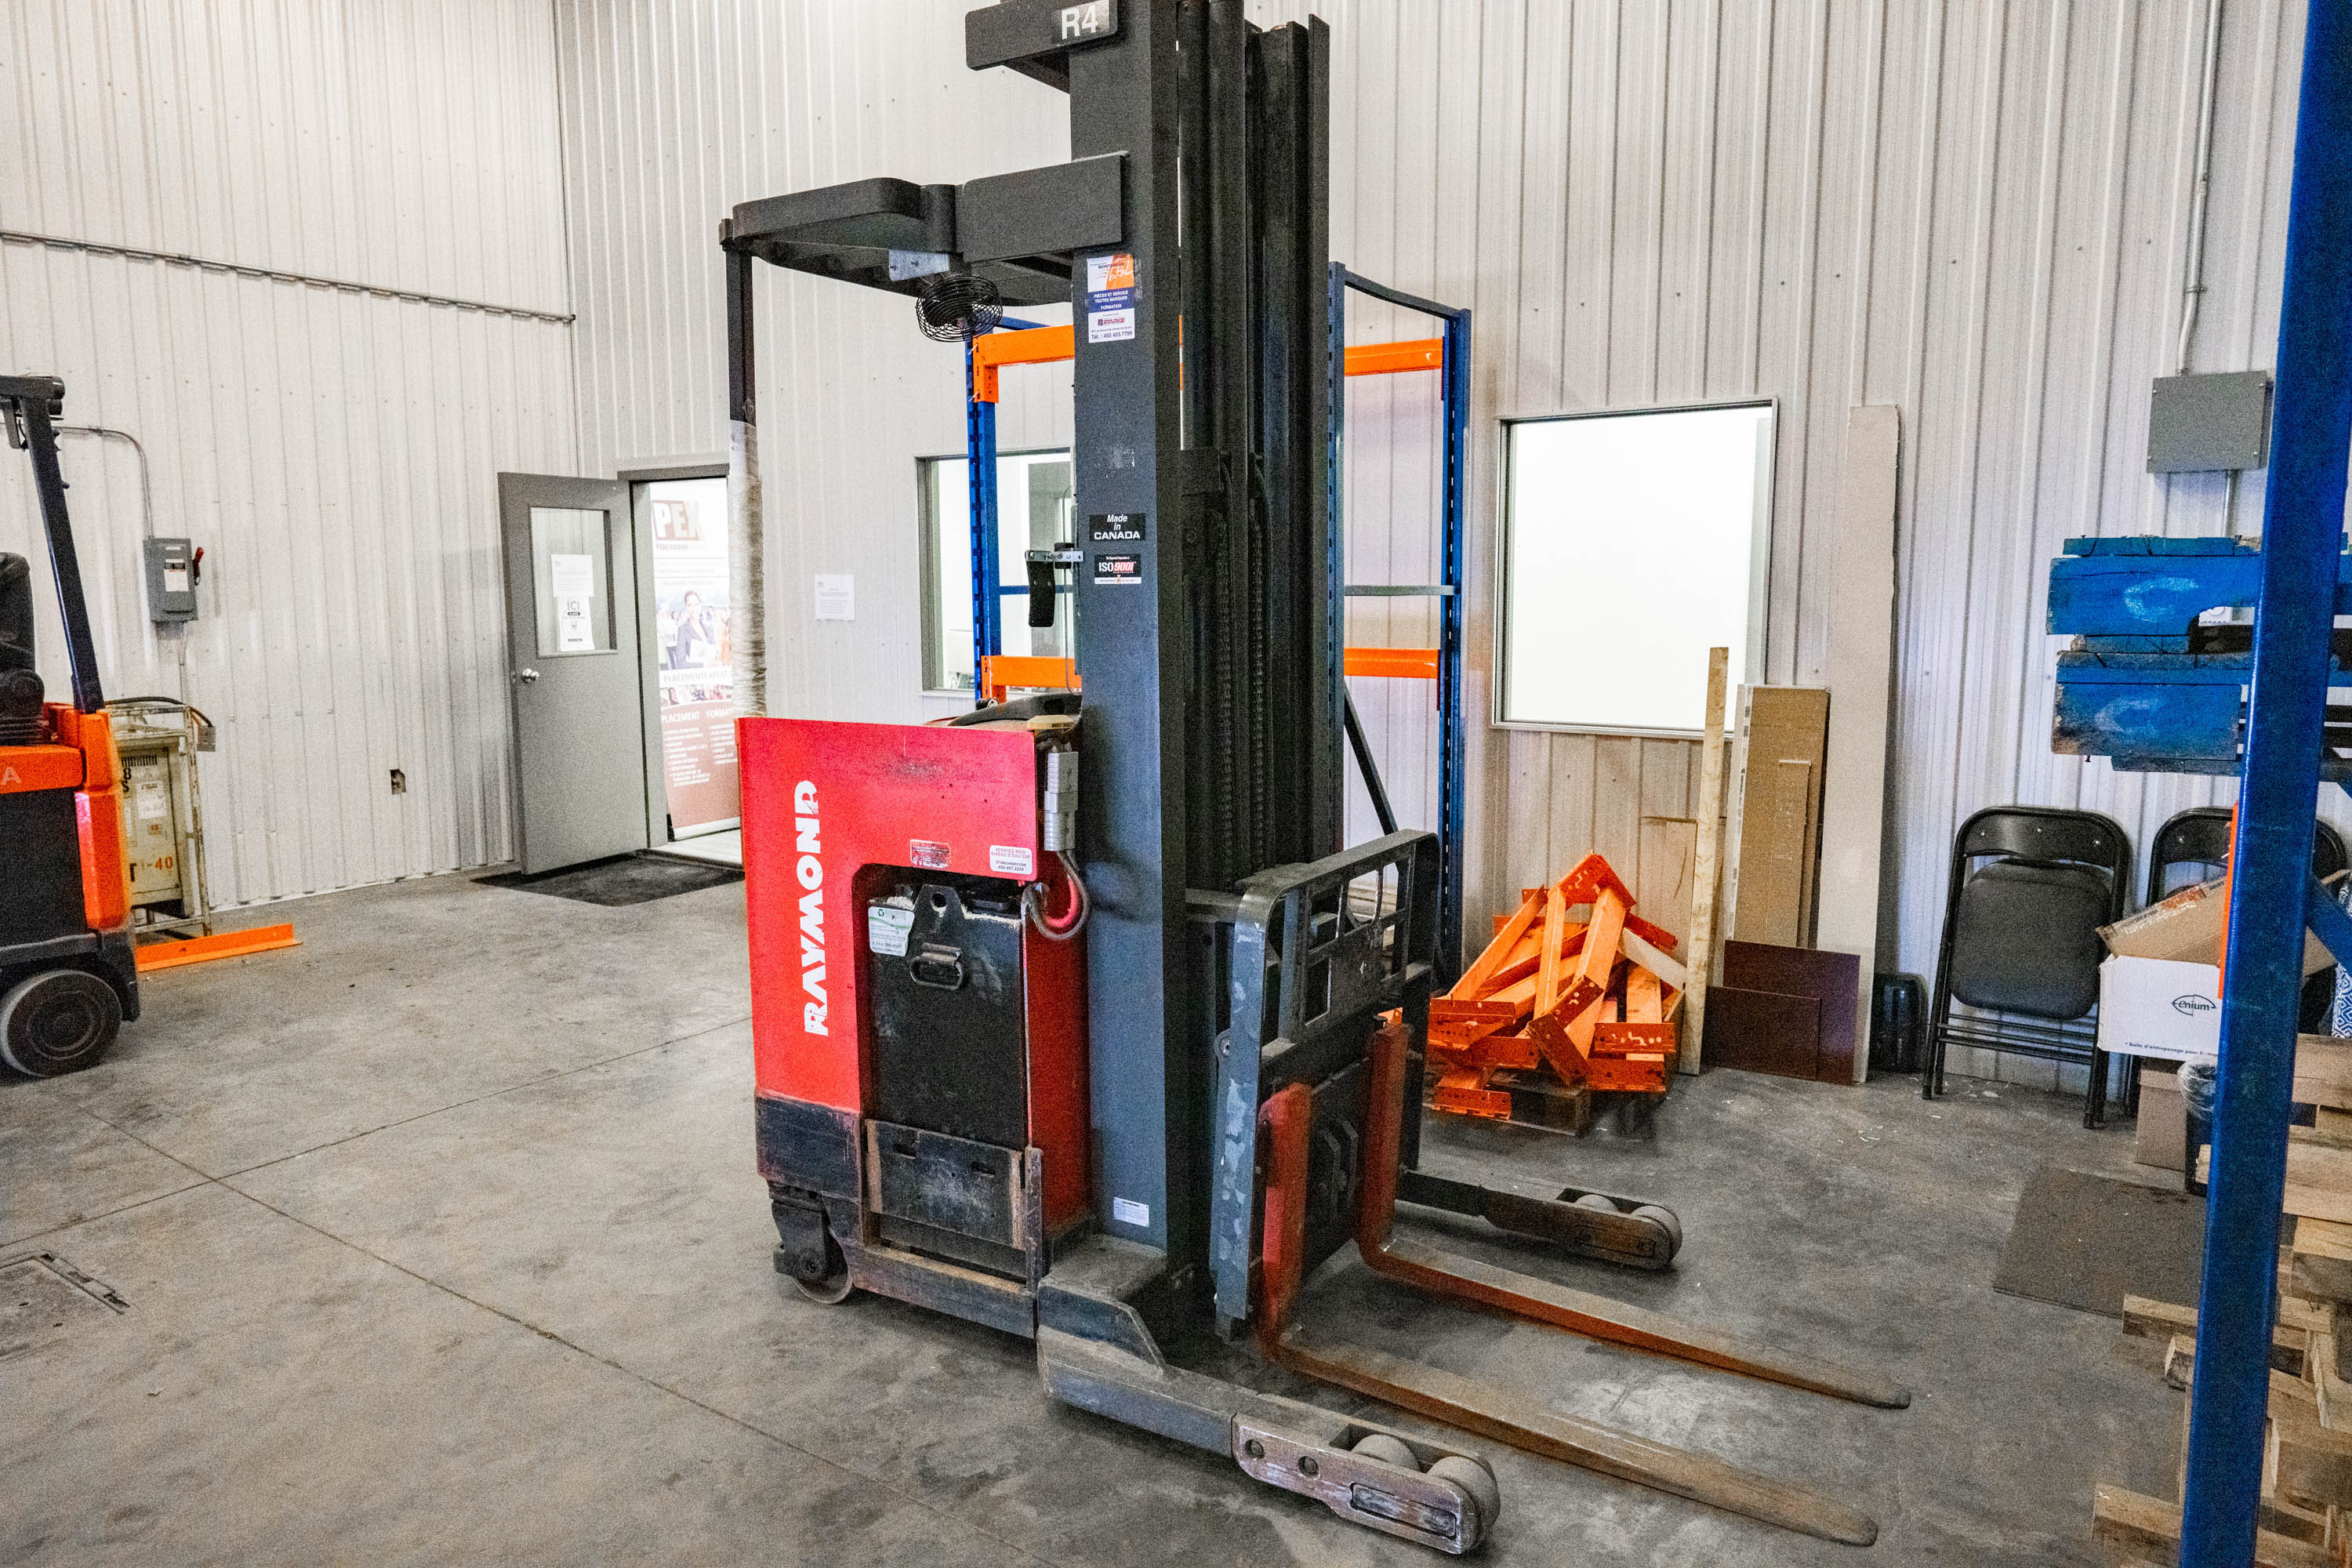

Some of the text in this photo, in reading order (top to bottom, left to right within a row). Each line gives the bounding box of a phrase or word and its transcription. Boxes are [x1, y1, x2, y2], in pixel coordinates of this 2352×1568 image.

[1062, 5, 1098, 40] R4
[1107, 514, 1128, 523] Made
[1113, 522, 1121, 531] in
[1094, 531, 1141, 540] CANADA
[794, 780, 829, 1036] RAYMOND
[2179, 1000, 2210, 1011] enium
